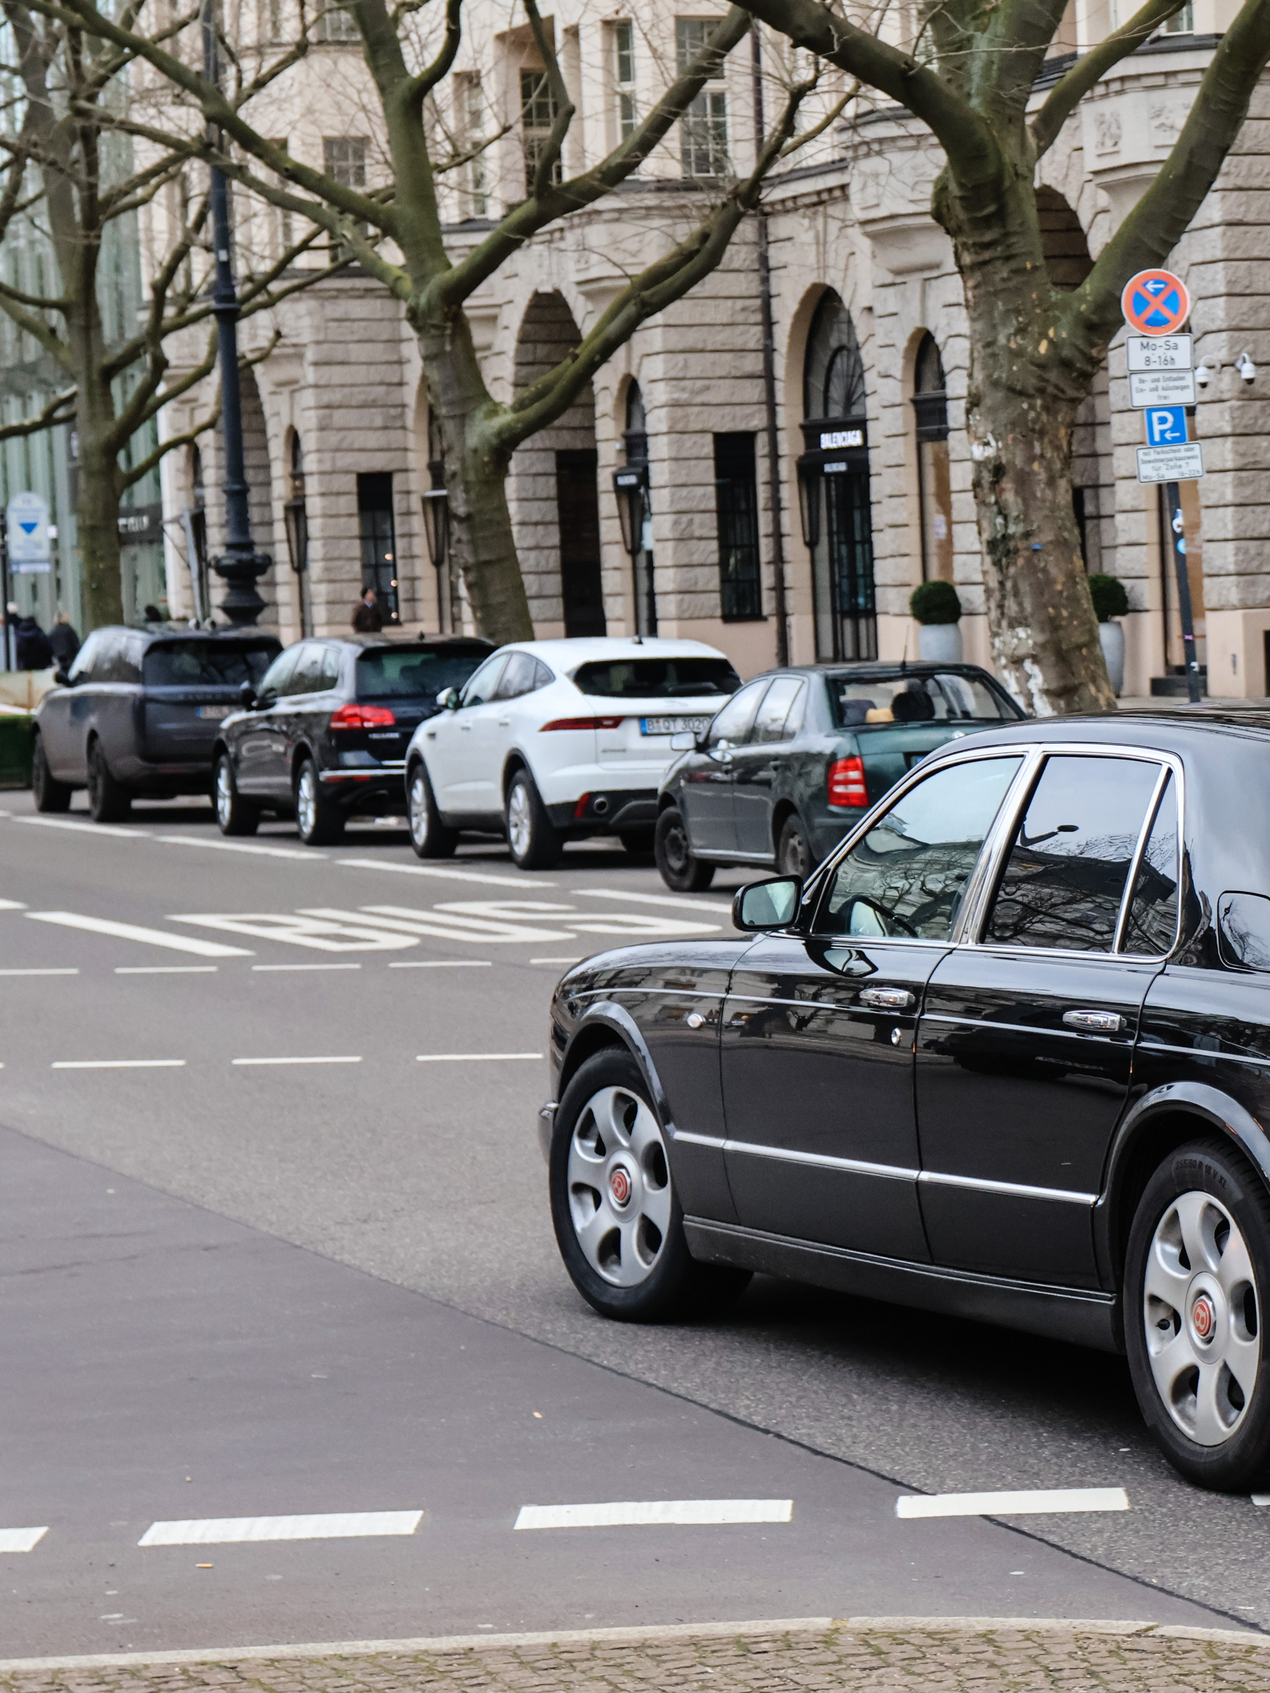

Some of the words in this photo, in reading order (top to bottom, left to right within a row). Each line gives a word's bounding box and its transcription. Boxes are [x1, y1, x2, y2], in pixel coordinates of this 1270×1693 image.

[1140, 340, 1178, 351] Mo-Sa
[1144, 355, 1175, 367] 8-16h
[1151, 411, 1174, 442] P
[164, 901, 722, 952] BUS
